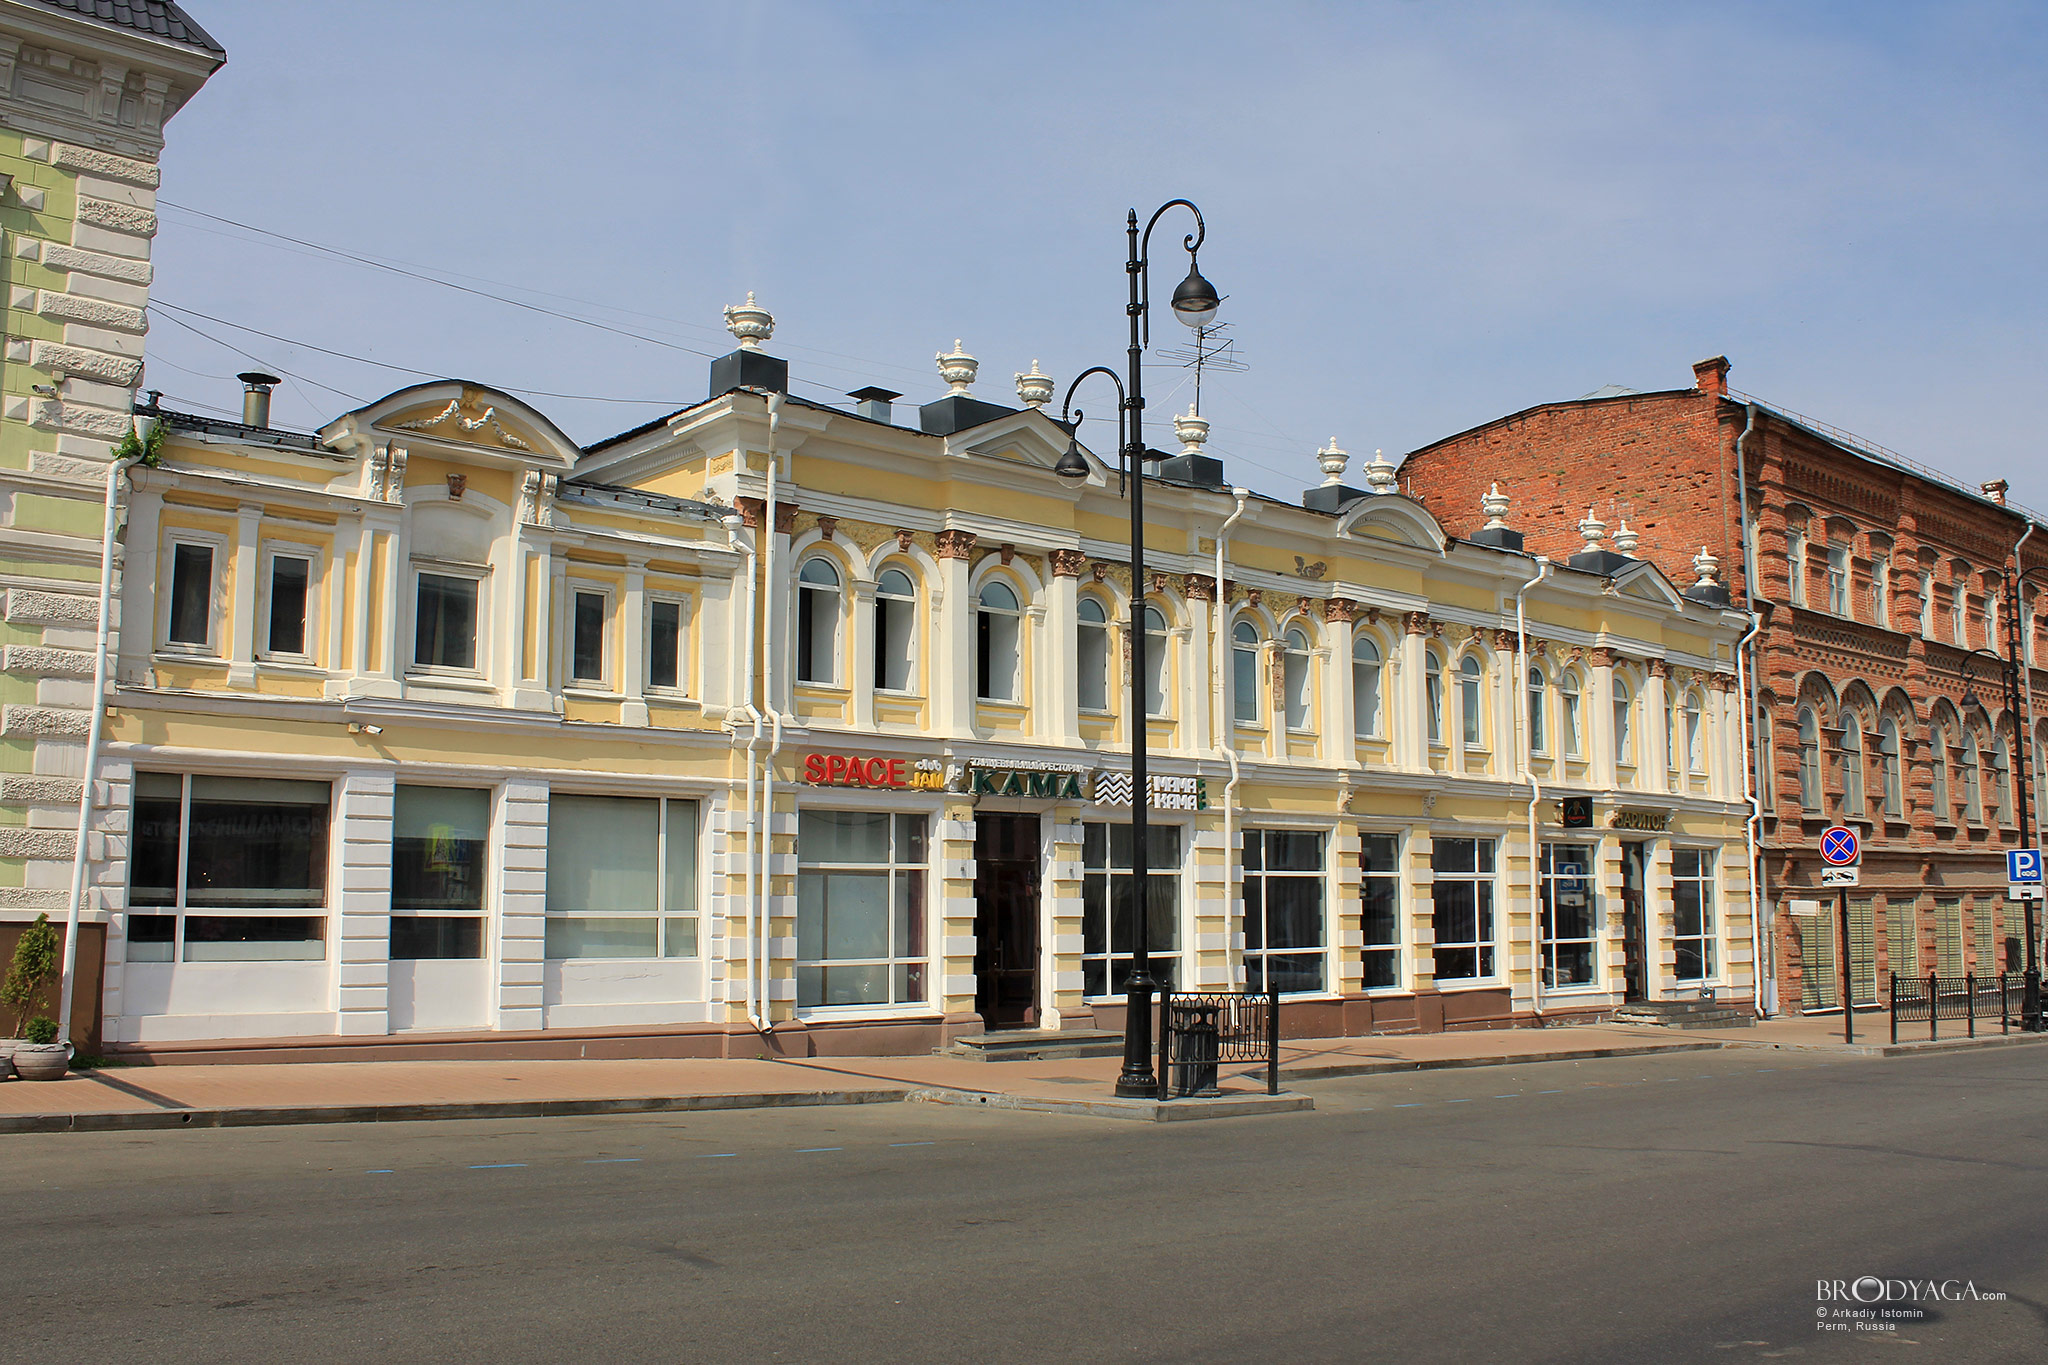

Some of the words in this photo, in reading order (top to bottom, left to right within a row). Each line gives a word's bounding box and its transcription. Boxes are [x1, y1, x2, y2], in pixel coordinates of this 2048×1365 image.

[804, 753, 906, 787] SPACE
[909, 771, 945, 789] JAM
[914, 758, 943, 772] club
[968, 767, 1084, 799] КАМА
[1153, 776, 1197, 793] МАМА
[1154, 793, 1198, 811] КАМА
[1616, 811, 1666, 830] БАРИТОН
[2014, 852, 2034, 878] P
